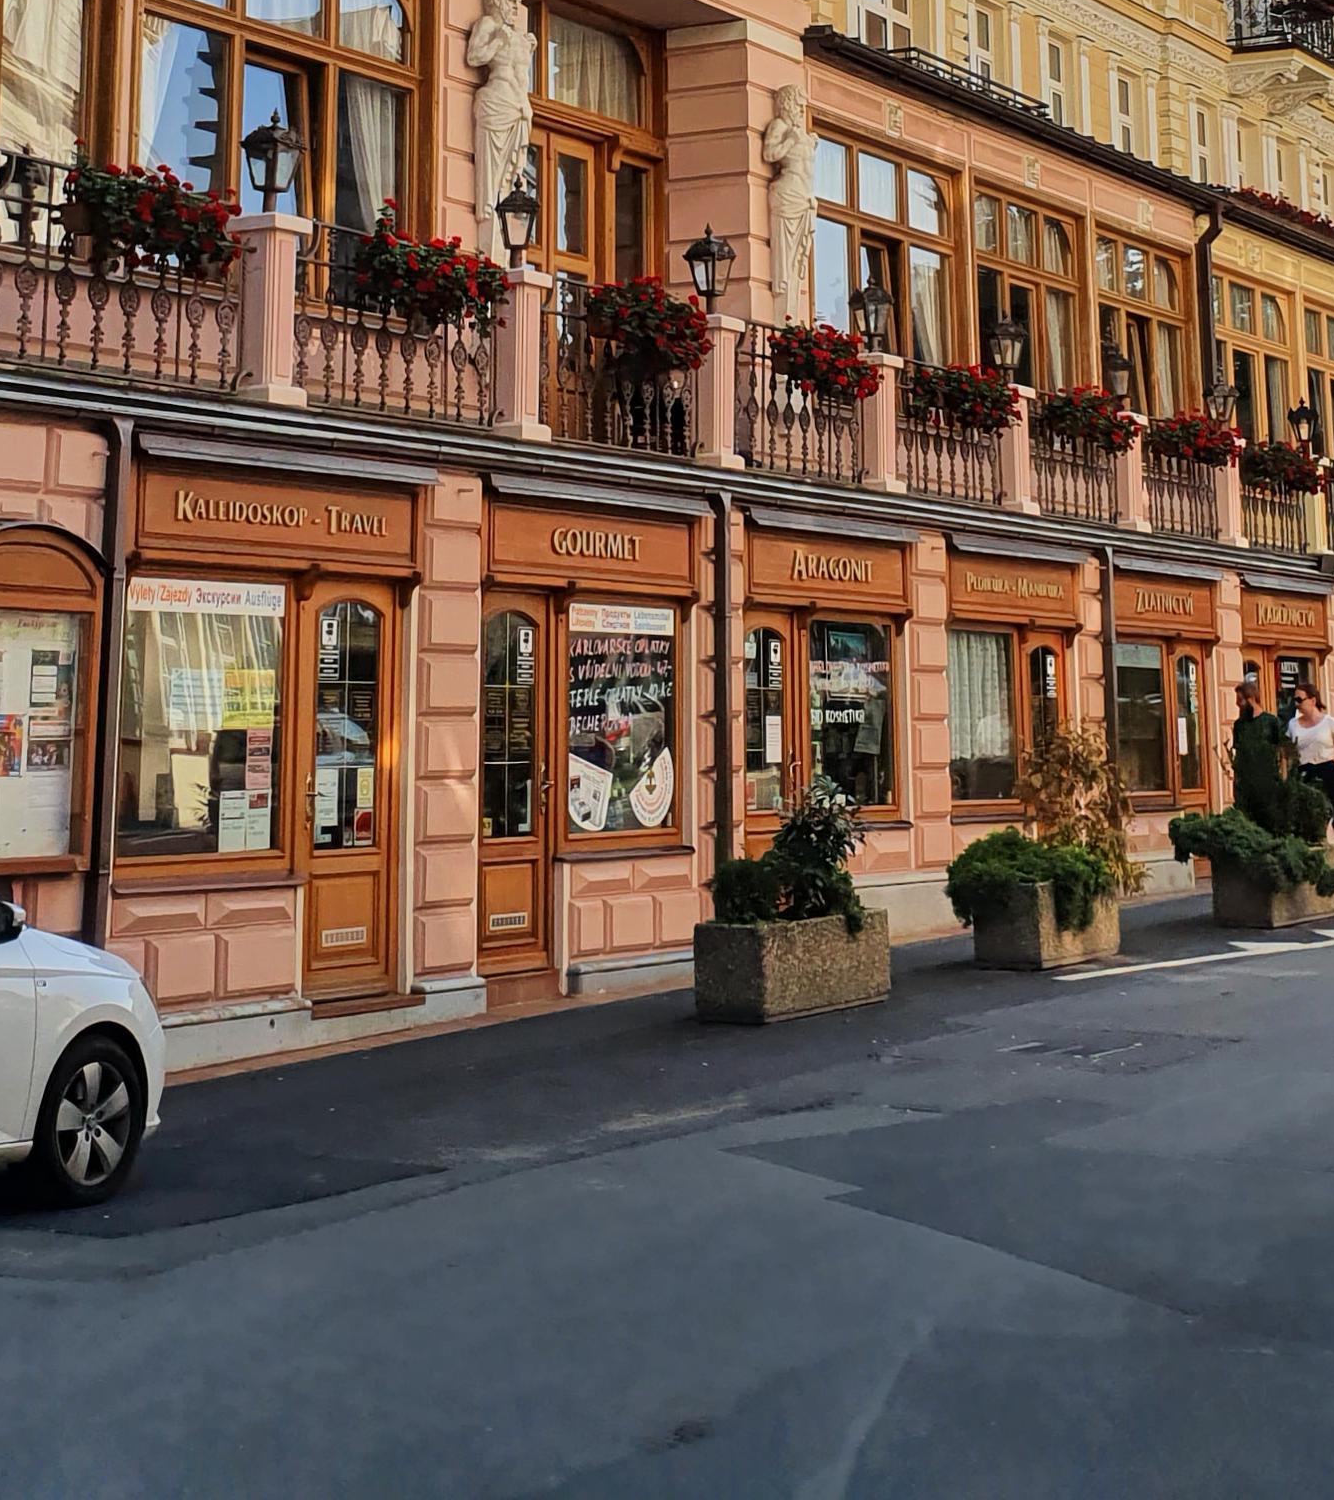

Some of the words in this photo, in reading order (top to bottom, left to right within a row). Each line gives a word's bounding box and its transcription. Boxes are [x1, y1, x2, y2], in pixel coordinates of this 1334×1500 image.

[175, 489, 308, 527] KALEIDOSKOP
[325, 505, 388, 537] TRAVEL
[552, 527, 643, 561] GOURMET
[791, 548, 873, 583] ARAGONIT
